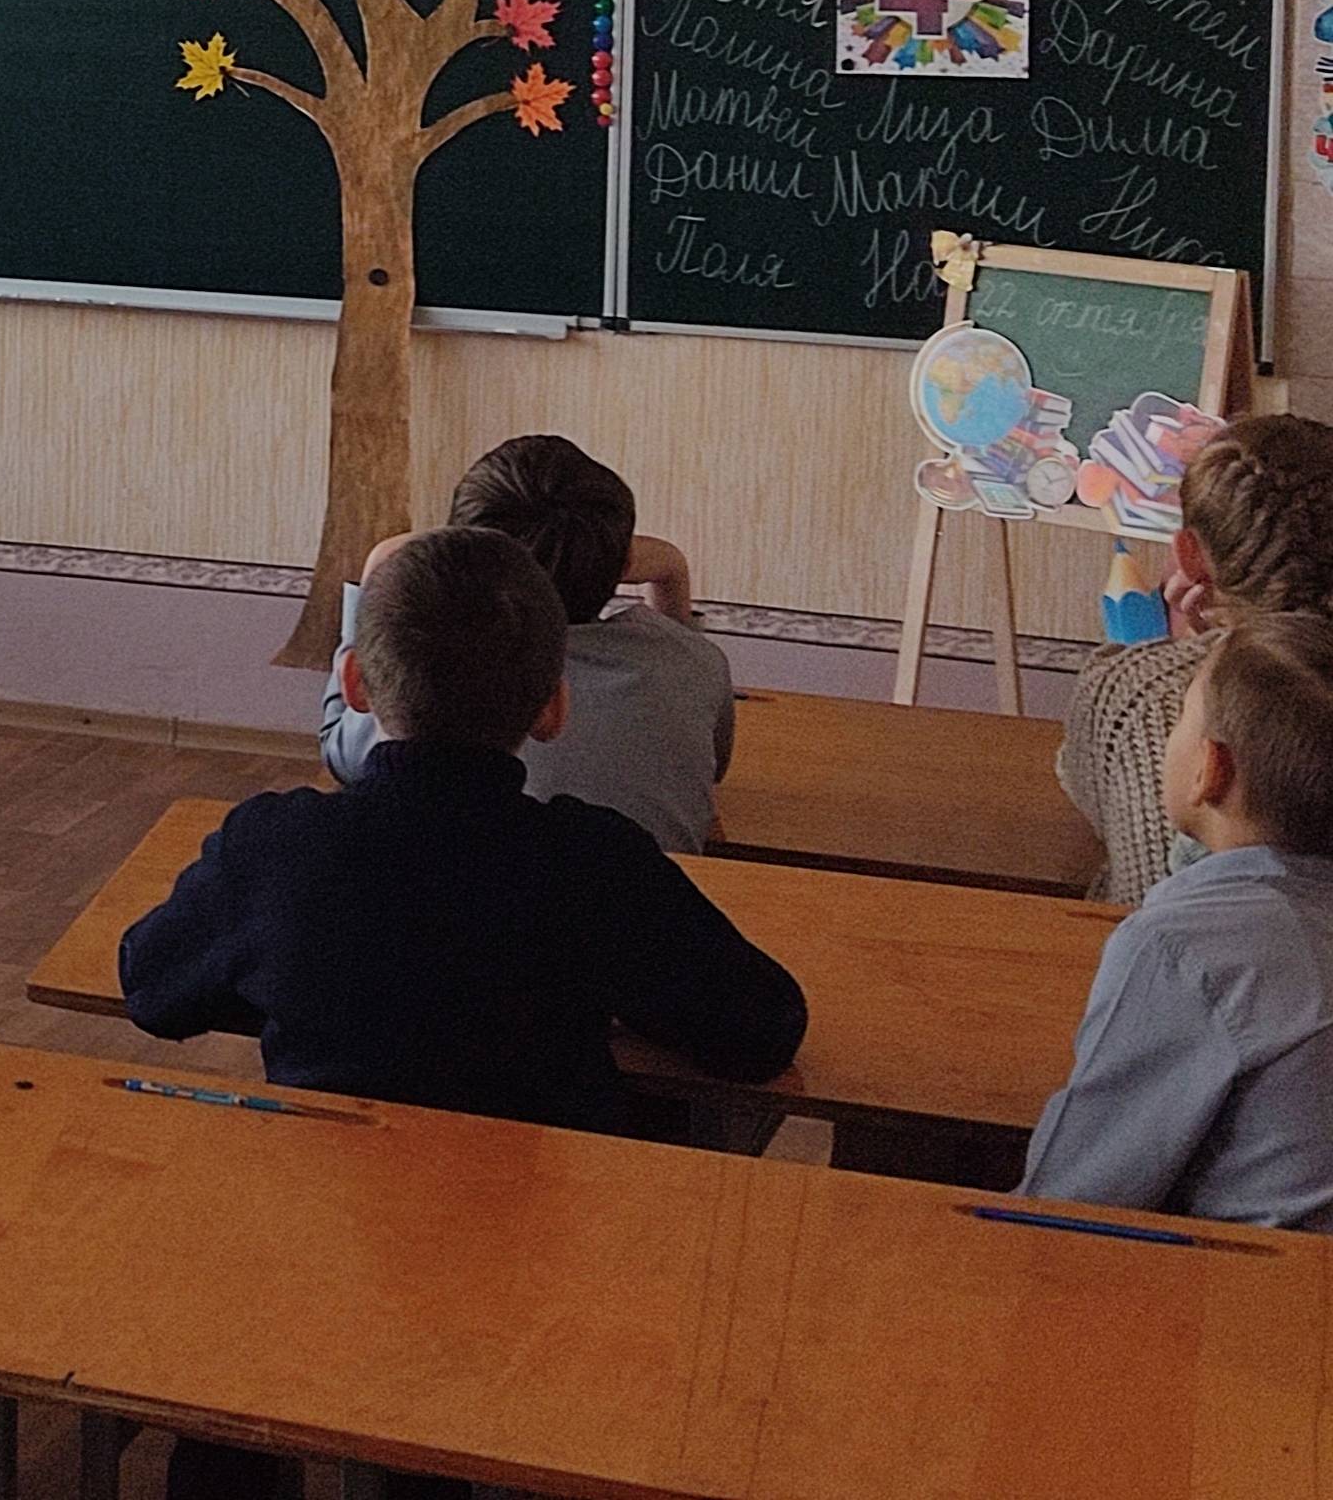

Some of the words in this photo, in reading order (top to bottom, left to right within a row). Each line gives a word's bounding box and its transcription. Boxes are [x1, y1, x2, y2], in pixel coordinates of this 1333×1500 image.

[636, 69, 822, 159] Матвей
[856, 78, 1007, 176] Лиза
[1031, 95, 1218, 170] Дима
[811, 149, 1056, 247] Максим
[656, 211, 797, 289] Поля
[976, 278, 1018, 320] 22
